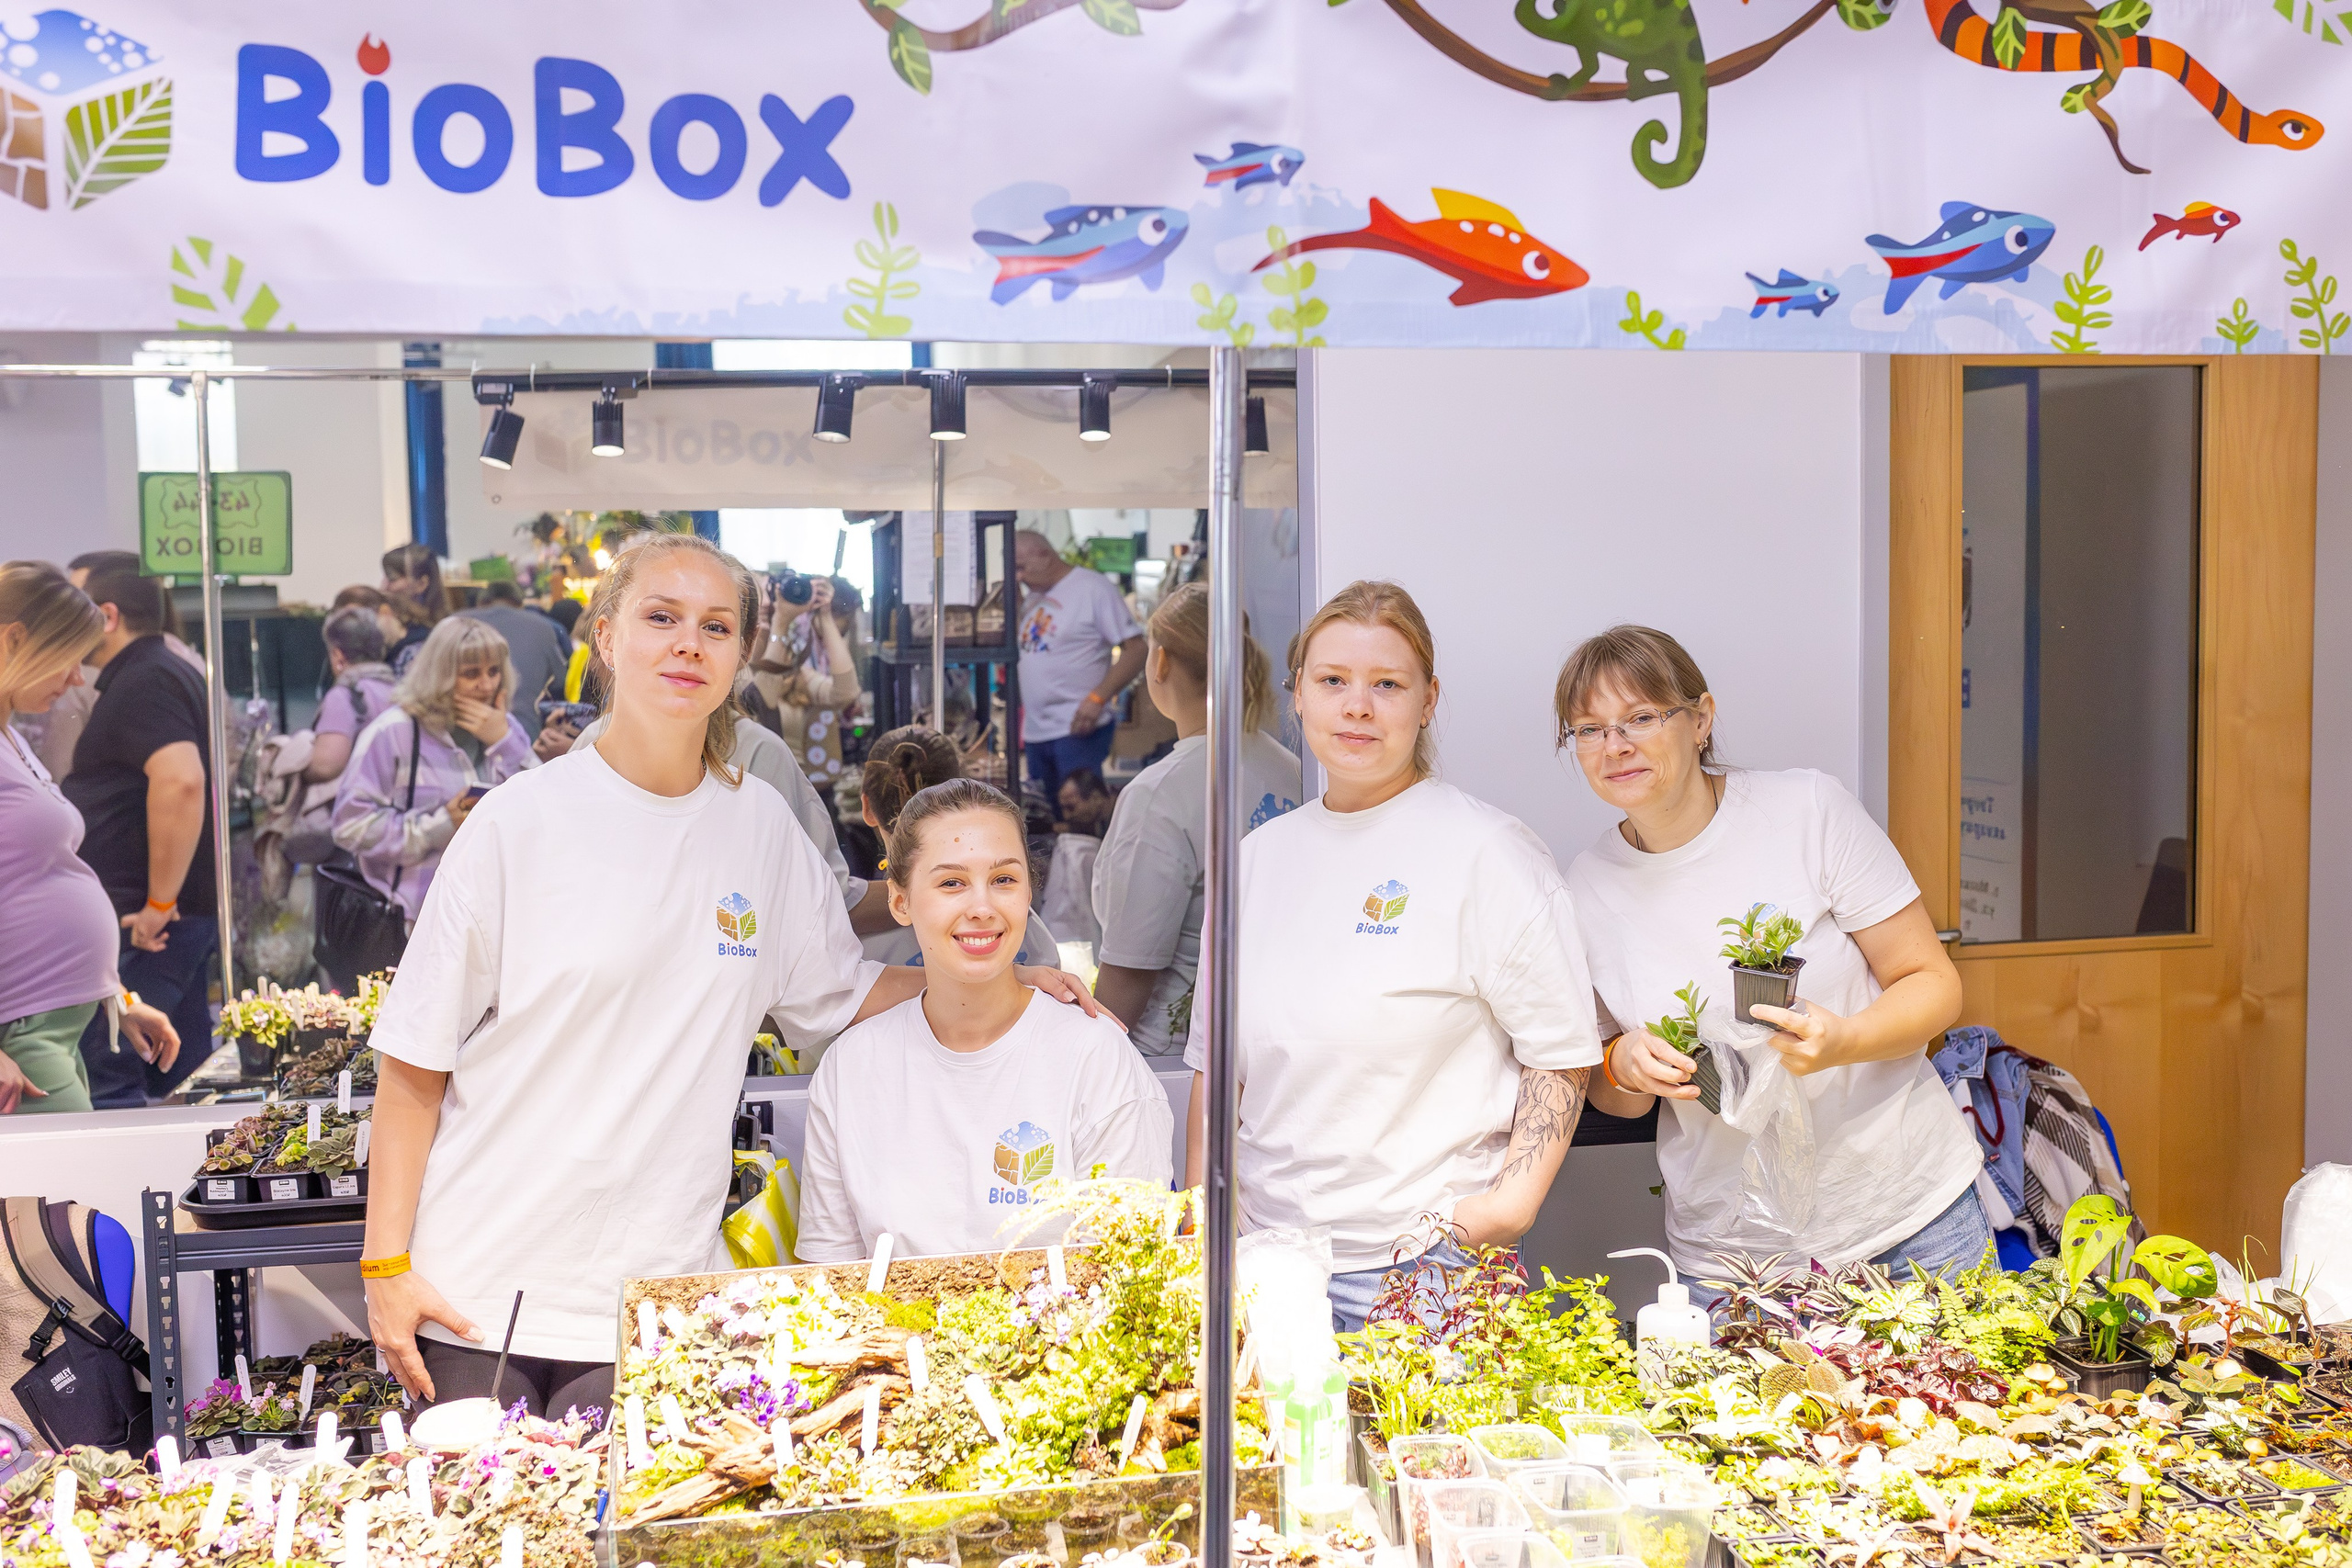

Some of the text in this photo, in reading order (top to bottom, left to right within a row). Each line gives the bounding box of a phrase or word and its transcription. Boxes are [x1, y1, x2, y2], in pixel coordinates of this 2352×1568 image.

[235, 31, 855, 209] BioBox
[622, 415, 815, 466] BioBox
[1355, 922, 1399, 935] BioBox
[718, 942, 758, 957] BioBox
[51, 1367, 73, 1386] SMILEY
